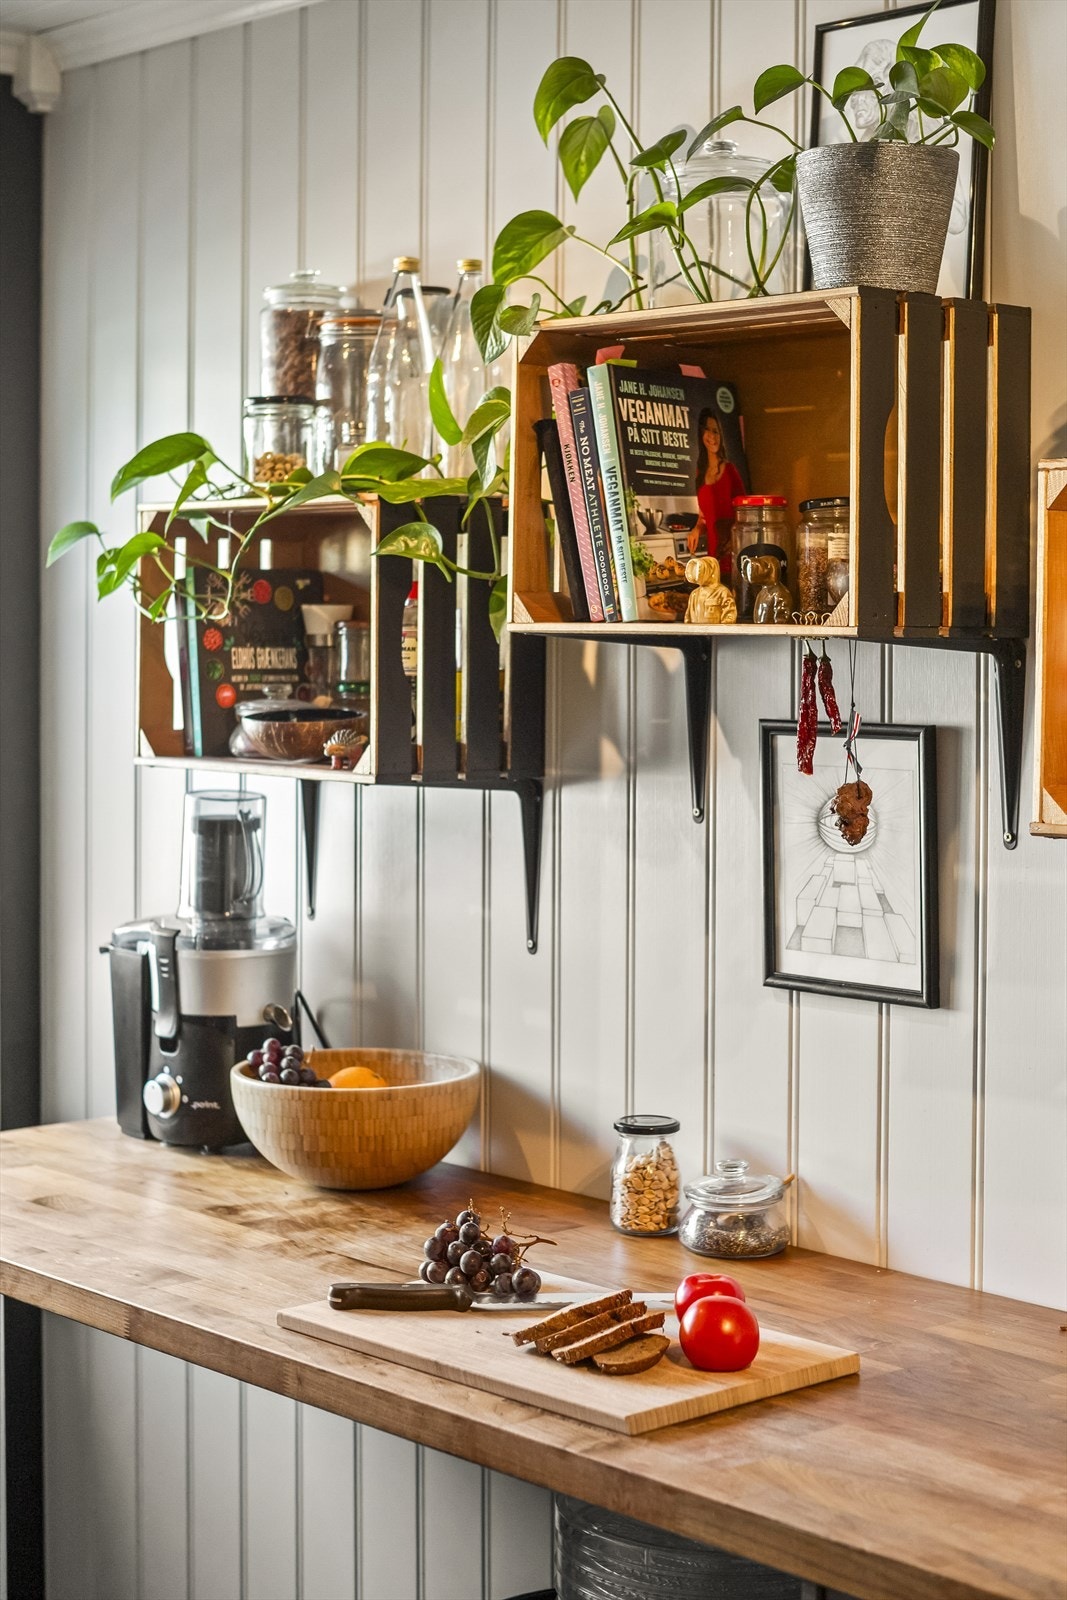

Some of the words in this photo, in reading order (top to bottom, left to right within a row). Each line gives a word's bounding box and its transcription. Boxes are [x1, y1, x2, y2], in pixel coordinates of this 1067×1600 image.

[594, 381, 605, 401] JANE
[619, 380, 638, 395] JANE
[639, 382, 647, 396] H.
[648, 384, 685, 401] JOHANSEN
[618, 397, 690, 429] VEGANMAT
[580, 436, 590, 455] NO
[598, 414, 612, 455] JOHANSEN
[627, 423, 640, 443] PÅ
[641, 428, 660, 446] SITT
[662, 431, 690, 449] BESTE
[583, 458, 596, 491] MEAT
[605, 465, 624, 532] VEGANMAT
[588, 493, 603, 547] ATHLETE
[598, 550, 610, 596] COOKBOOK
